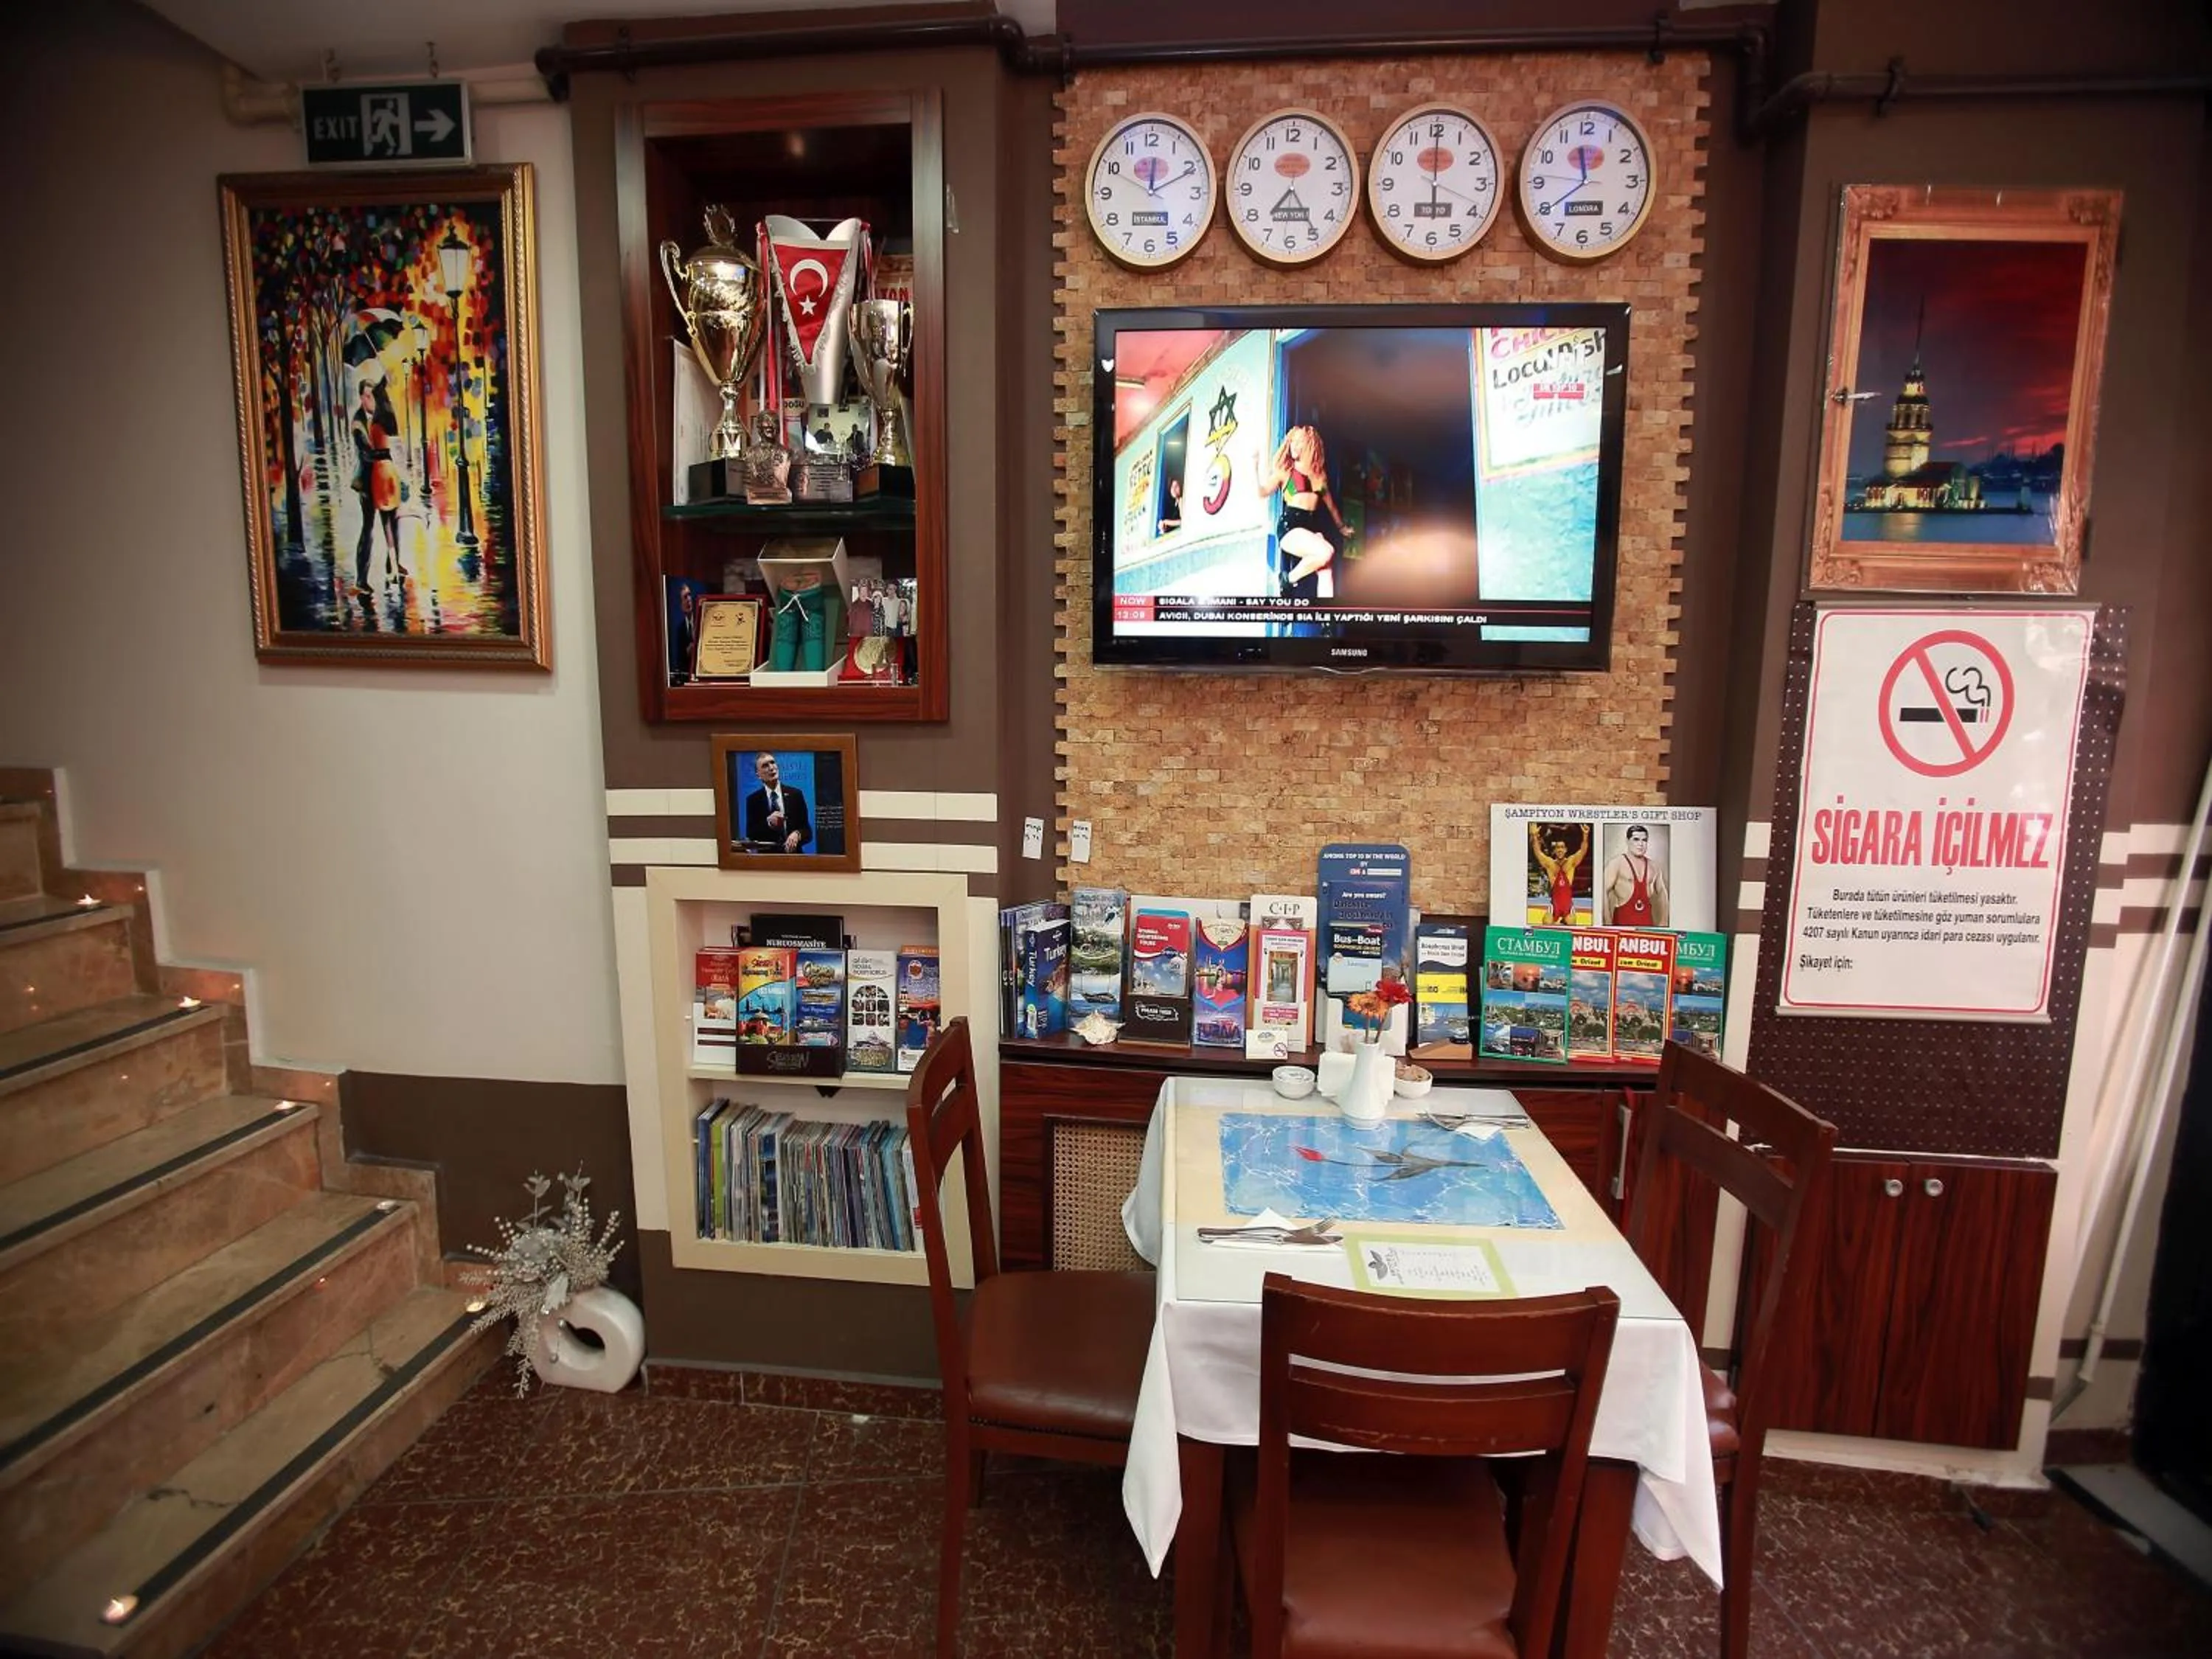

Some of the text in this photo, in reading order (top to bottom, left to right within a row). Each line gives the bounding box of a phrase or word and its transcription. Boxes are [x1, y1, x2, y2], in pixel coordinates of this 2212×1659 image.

[313, 116, 358, 140] EXIT
[1430, 124, 1444, 137] 12
[1580, 122, 1595, 136] 12
[1144, 133, 1158, 147] 12
[1286, 128, 1301, 142] 12
[1410, 132, 1418, 145] 11
[1458, 131, 1462, 145] 1
[1559, 130, 1568, 143] 11
[1608, 130, 1612, 143] 1
[1125, 142, 1133, 155] 11
[1172, 141, 1176, 154] 1
[1266, 137, 1275, 150] 11
[1314, 137, 1318, 150] 1
[1391, 152, 1403, 165] 10
[1469, 152, 1481, 165] 2
[1541, 150, 1553, 164] 10
[1620, 150, 1631, 163] 2
[1108, 161, 1120, 175] 10
[1183, 161, 1195, 175] 2
[1248, 157, 1260, 170] 10
[1325, 157, 1337, 170] 2
[1382, 178, 1394, 191] 9
[1475, 178, 1486, 192] 3
[1533, 176, 1545, 189] 9
[1626, 175, 1638, 189] 3
[1100, 187, 1112, 200] 9
[1190, 187, 1201, 200] 3
[1240, 183, 1252, 195] 9
[1331, 183, 1343, 195] 3
[1246, 209, 1259, 221] 8
[1324, 209, 1335, 221] 4
[1388, 204, 1400, 217] 8
[1421, 206, 1446, 215] TOYO
[1467, 206, 1478, 218] 4
[1540, 202, 1551, 215] 8
[1568, 204, 1599, 213] LONDRA
[1618, 202, 1630, 215] 4
[1107, 212, 1119, 226] 8
[1183, 213, 1193, 226] 4
[1263, 229, 1273, 242] 7
[1307, 228, 1318, 240] 5
[1404, 224, 1414, 237] 7
[1449, 224, 1461, 237] 5
[1555, 223, 1565, 236] 7
[1600, 223, 1613, 235] 5
[1122, 232, 1133, 246] 7
[1166, 232, 1178, 244] 5
[1284, 236, 1295, 249] 6
[1426, 232, 1437, 245] 6
[1576, 231, 1588, 243] 6
[1144, 239, 1155, 252] 6
[1194, 612, 1225, 620] DUBAI
[1377, 613, 1401, 622] YENİ
[1456, 615, 1487, 625] ÇALDI
[1331, 648, 1368, 656] SAMSUNG
[1568, 809, 1639, 820] WRESTLER'S
[1641, 810, 1668, 820] GIFT
[1671, 810, 1702, 821] SHOP
[1812, 795, 2053, 875] SİGARA İÇİLMEZ
[1832, 888, 2018, 907] Burada tütün ürünleri tüketilmesi yasaktır.
[1807, 906, 2040, 925] Tüketenlere ve tüketilmesine göz yuman sorumlulara
[1803, 926, 1824, 939] 4207
[1826, 927, 1849, 942] sayılı
[1851, 927, 1879, 940] Kanun
[1921, 929, 1941, 941] idari
[1943, 932, 1964, 945] para
[1965, 932, 1994, 943] cezası
[1996, 932, 2040, 946] uygulanır.
[1498, 937, 1561, 955] СТАМБУЛ
[1572, 936, 1611, 953] NBUL
[1618, 937, 1669, 956] ANBUL
[1676, 942, 1716, 958] МБУЛ
[1043, 944, 1068, 962] Turkey
[1027, 950, 1037, 987] Turkey
[1799, 954, 1853, 972] Şikayet için:
